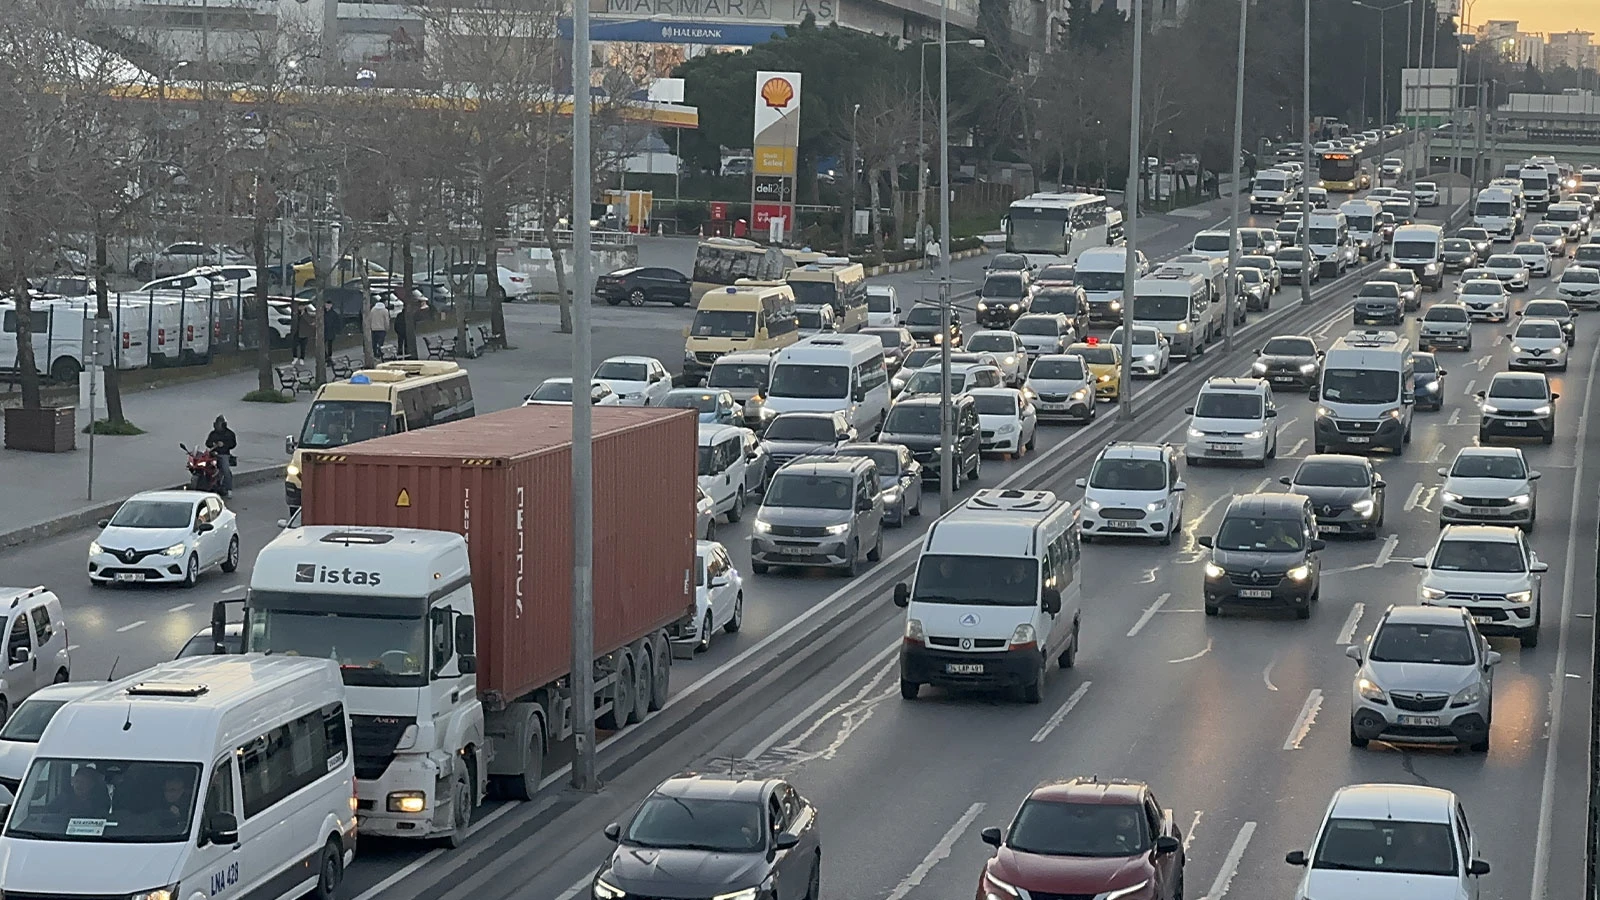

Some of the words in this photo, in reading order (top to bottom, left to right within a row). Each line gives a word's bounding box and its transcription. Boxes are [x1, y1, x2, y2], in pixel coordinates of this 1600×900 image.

[673, 28, 722, 38] HALKBANK
[320, 565, 381, 587] istaş
[211, 869, 225, 896] LNA
[226, 861, 239, 886] 428
